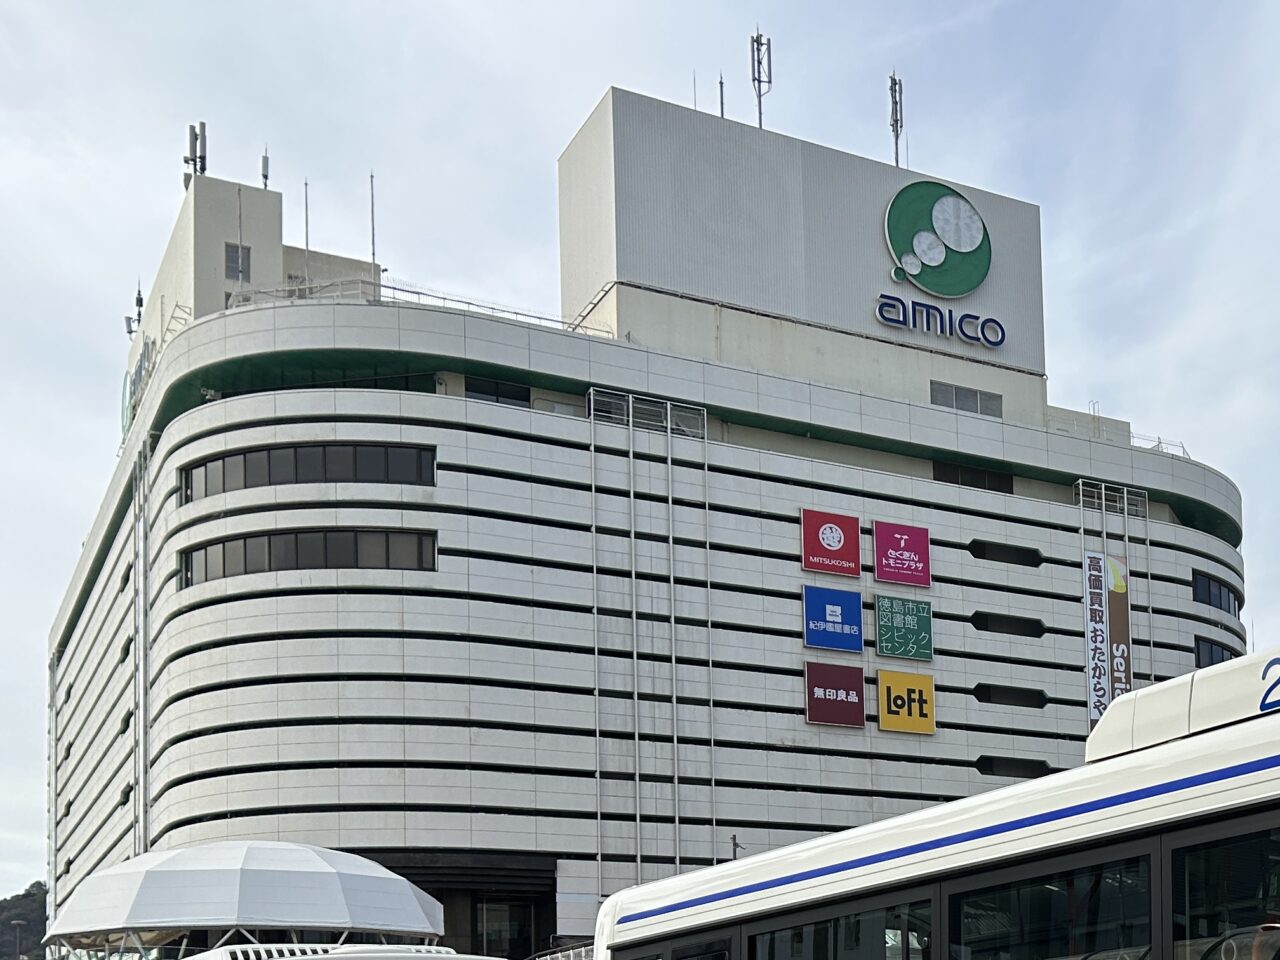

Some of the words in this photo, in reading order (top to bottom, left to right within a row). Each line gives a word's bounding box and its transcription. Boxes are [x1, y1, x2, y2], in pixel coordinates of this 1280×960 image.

[876, 293, 1006, 349] amico
[809, 556, 855, 568] MITSUKOSHI
[882, 557, 924, 570] トモニプラザ
[879, 597, 930, 617] 徳島市立
[880, 612, 918, 629] 図書館
[880, 627, 929, 645] シビック
[880, 640, 931, 656] センター
[814, 686, 859, 703] 無印良品
